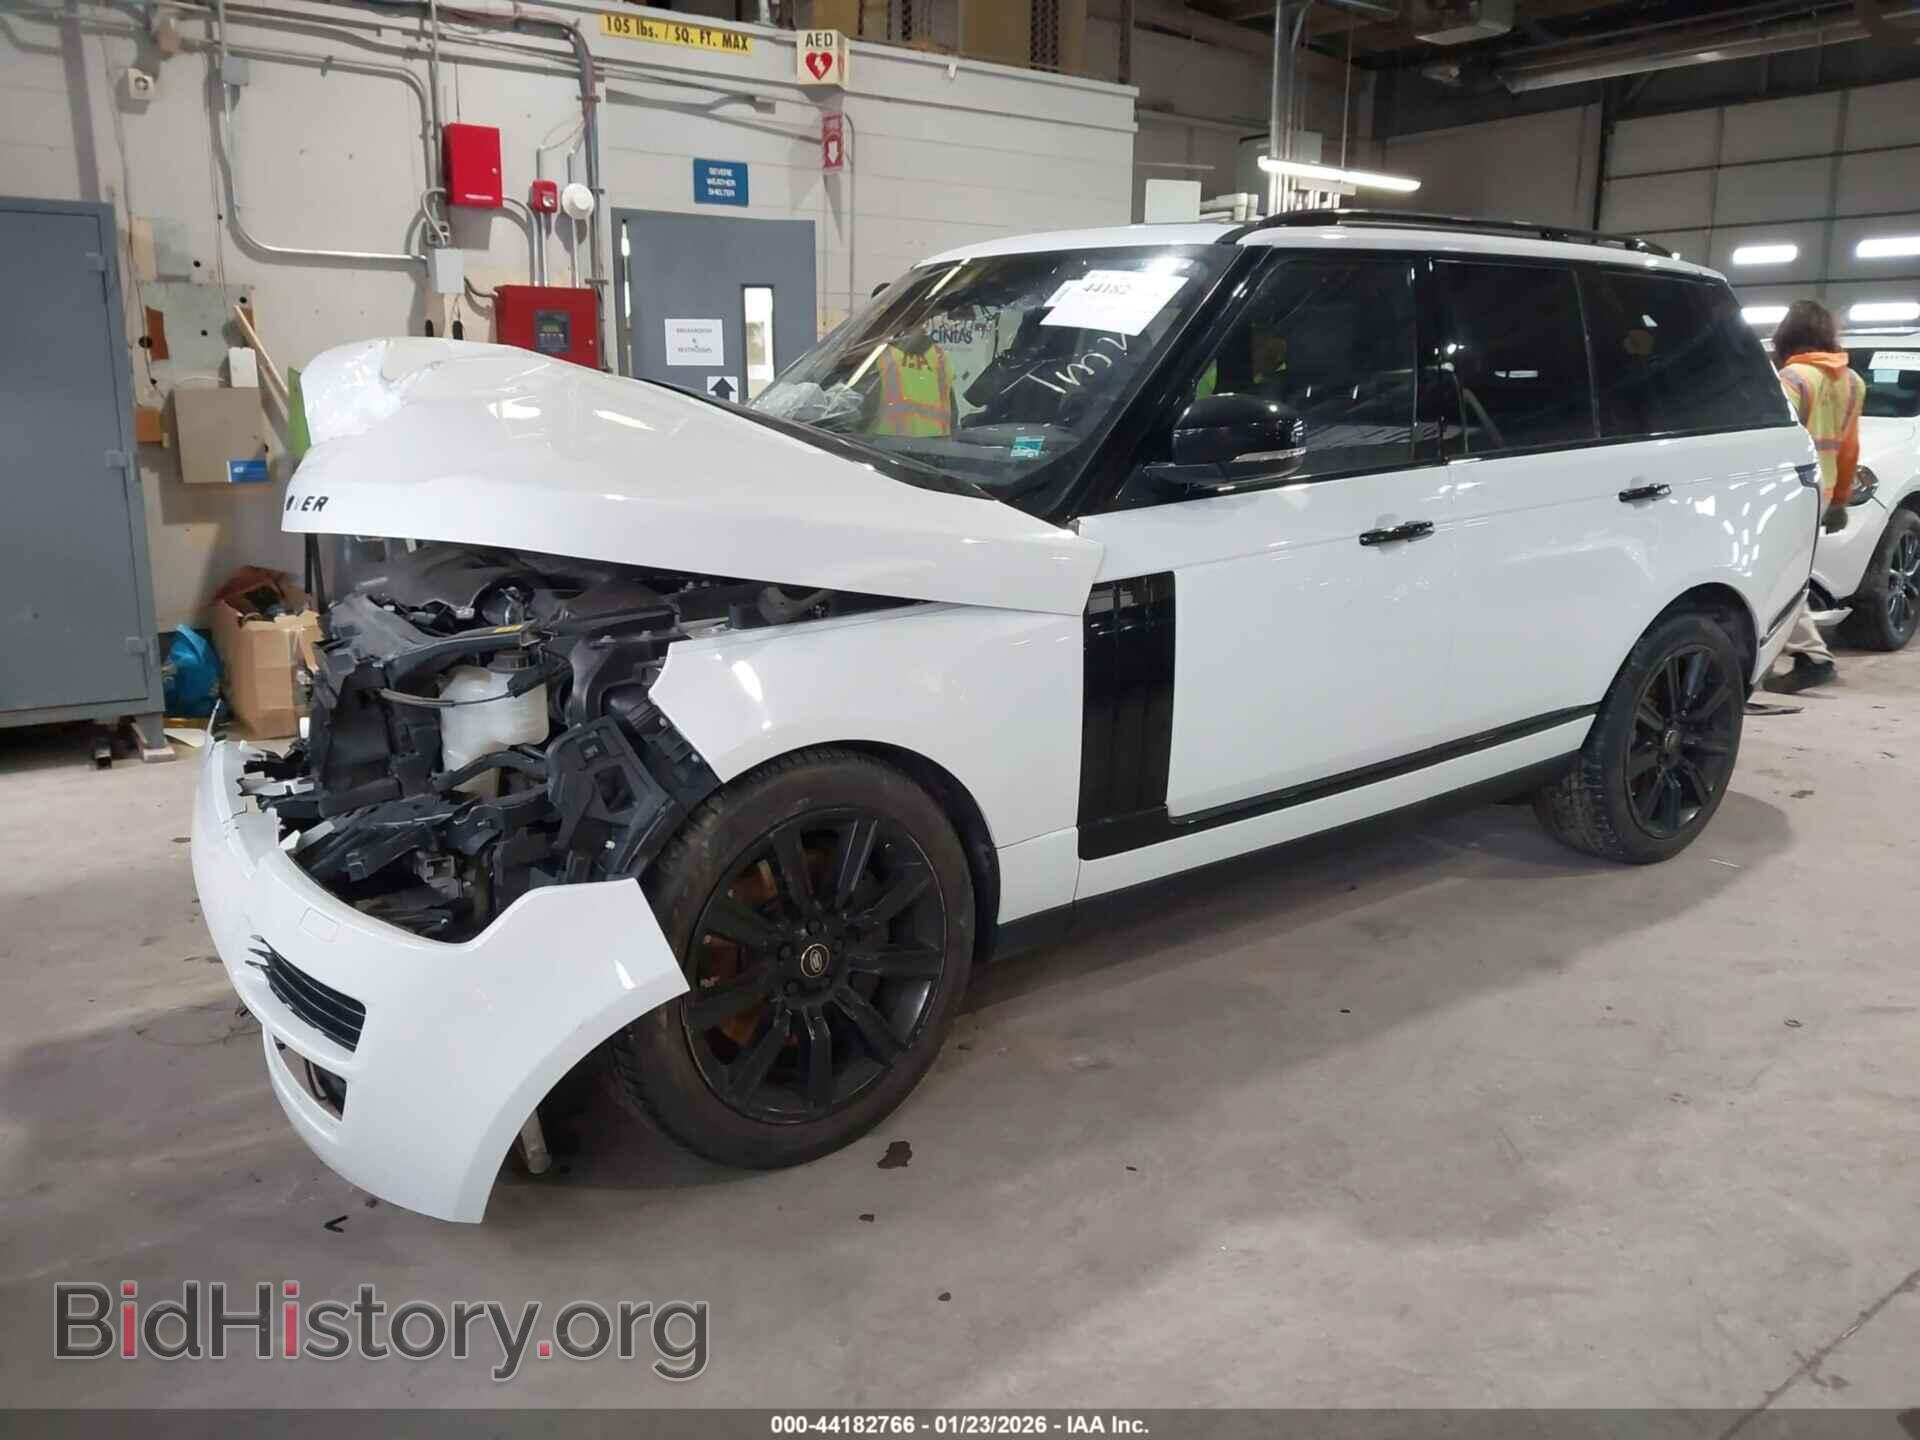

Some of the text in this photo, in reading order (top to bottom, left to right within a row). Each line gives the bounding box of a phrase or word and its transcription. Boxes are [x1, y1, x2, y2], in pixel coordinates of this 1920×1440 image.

[606, 16, 749, 51] 105 lbs. / SQ. FT. MAX
[805, 31, 834, 48] AED
